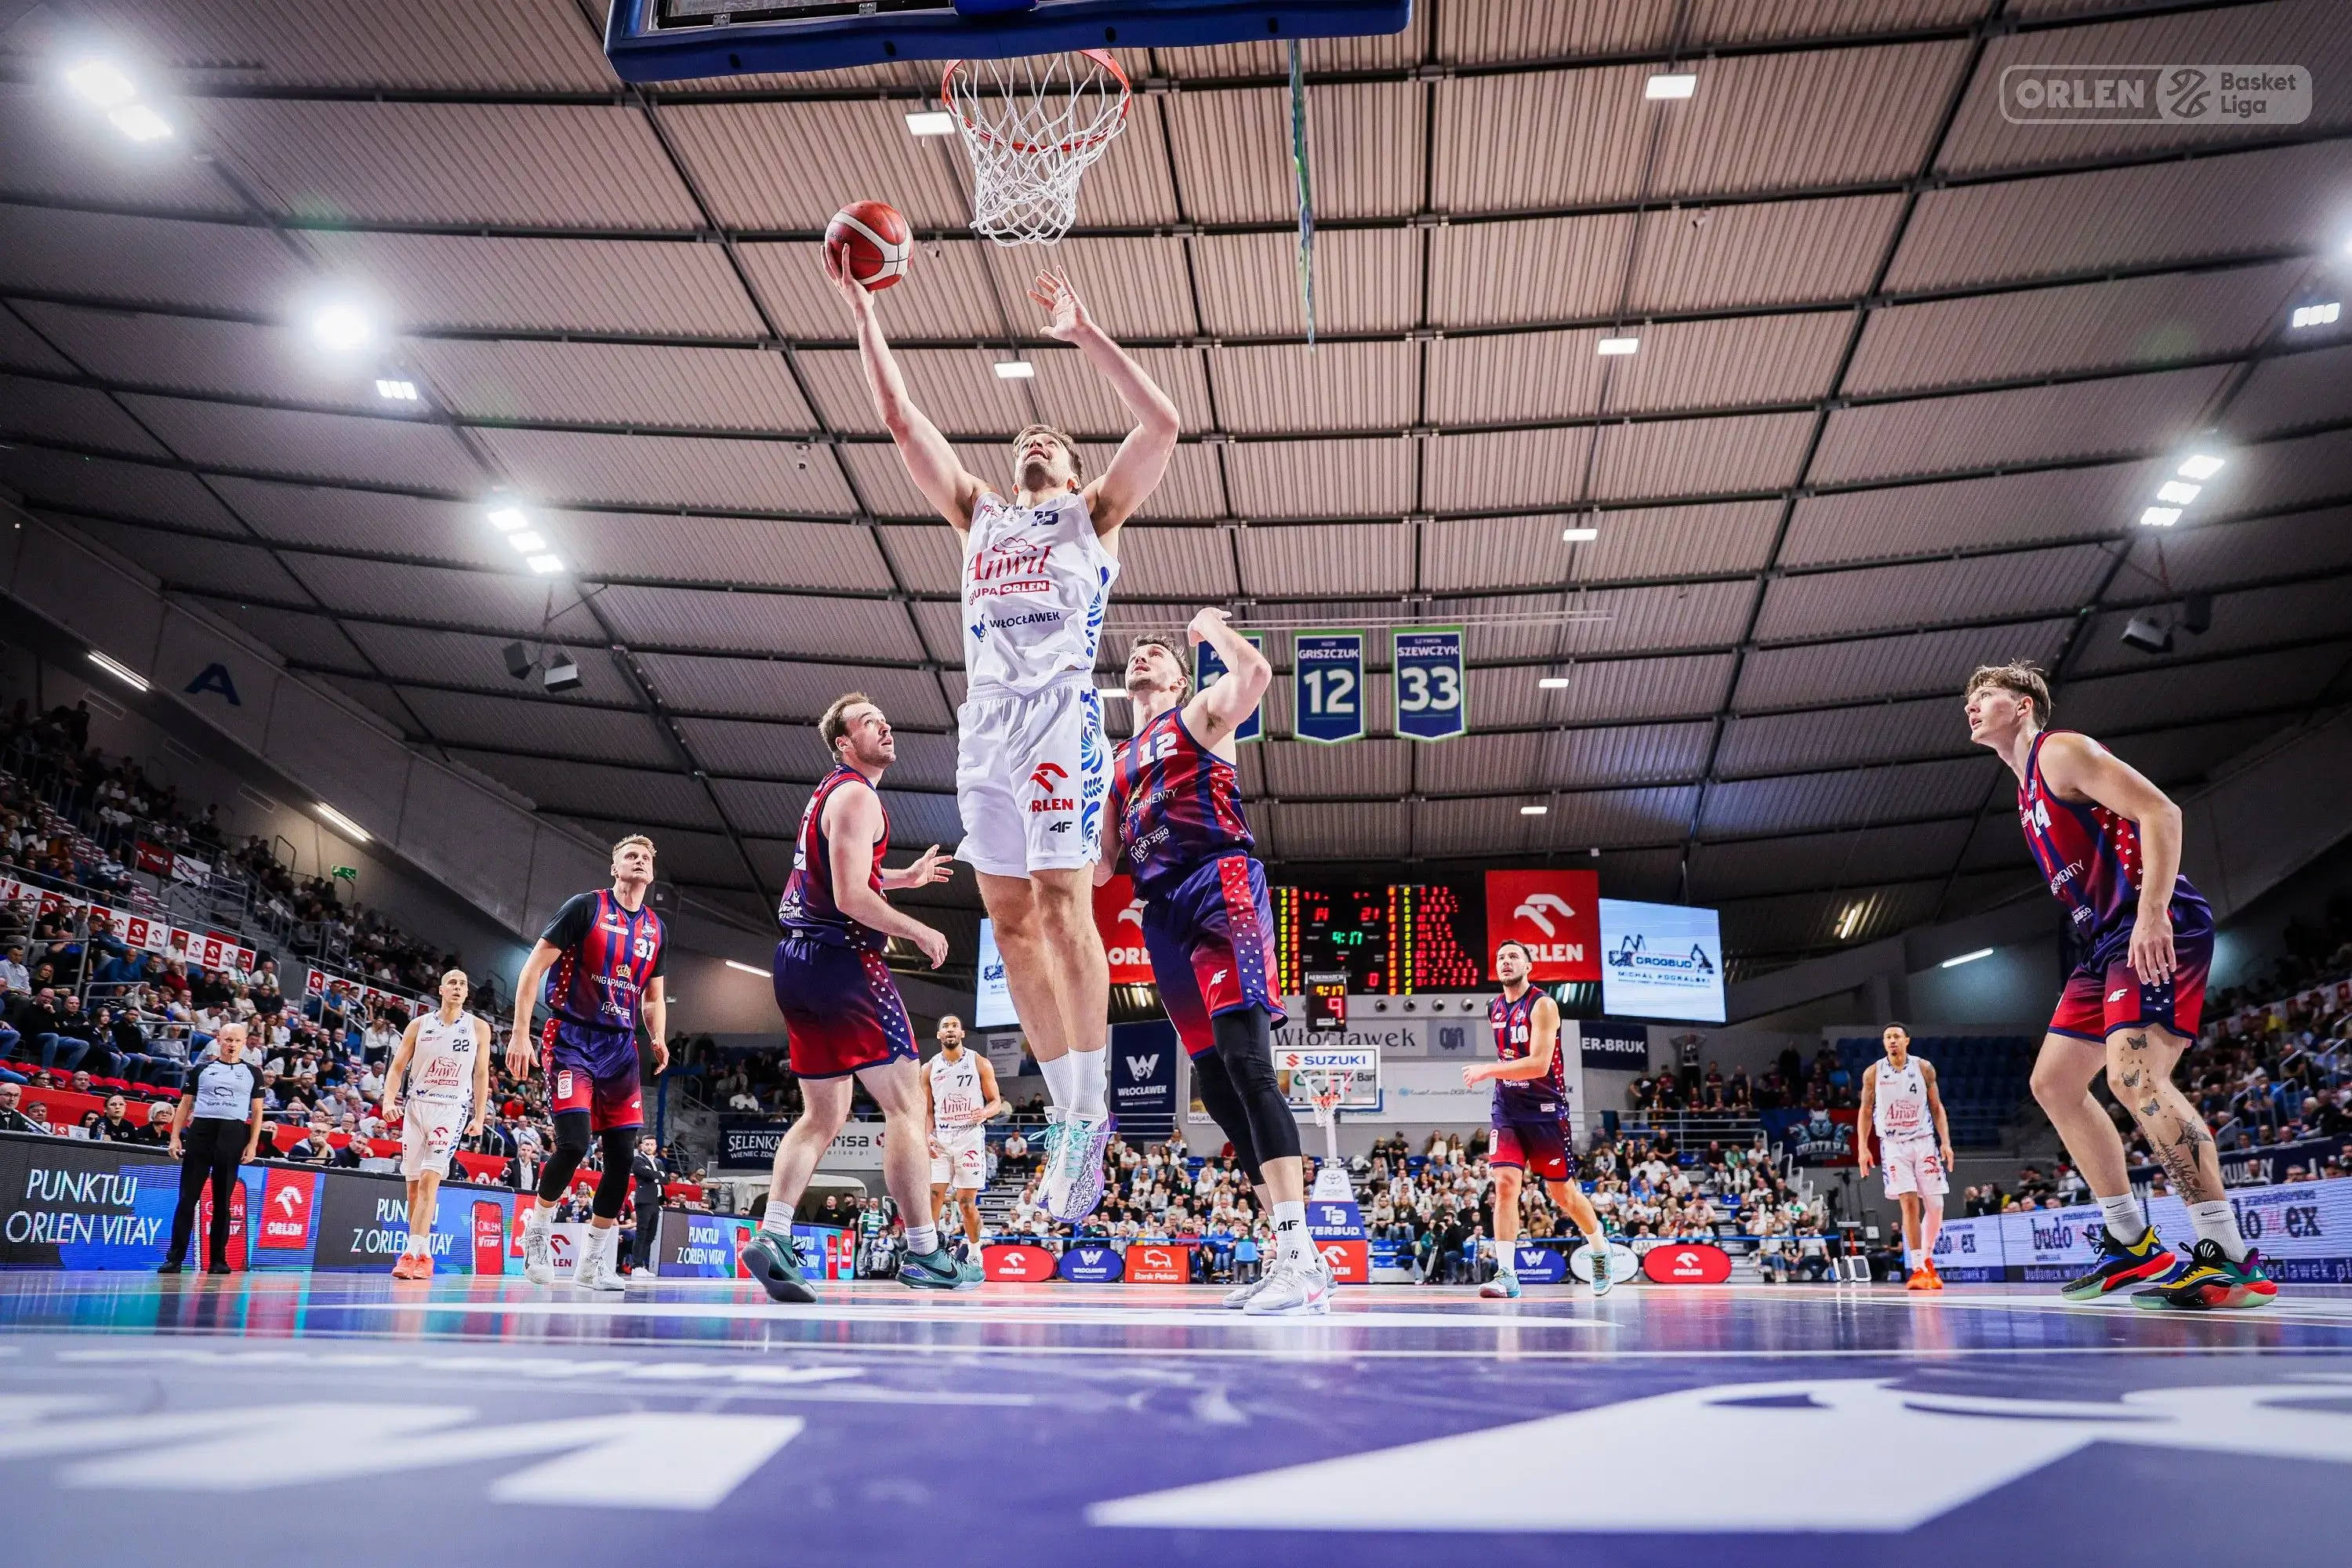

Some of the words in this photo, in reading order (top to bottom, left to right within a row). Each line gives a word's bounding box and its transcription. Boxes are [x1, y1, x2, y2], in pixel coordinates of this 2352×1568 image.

[967, 546, 1051, 588] Anwil
[968, 586, 998, 606] GRUPA
[1003, 580, 1047, 593] ORLEN
[989, 612, 1061, 629] WŁOCŁAWEK
[1398, 645, 1459, 657] SZEWCZYK
[183, 662, 242, 706] A
[1303, 669, 1355, 713] 12
[1400, 666, 1460, 711] 33
[1138, 732, 1178, 768] 12
[1029, 798, 1073, 812] RLEN
[1150, 828, 1169, 844] 2050
[1360, 907, 1380, 921] 21
[634, 938, 656, 961] 31
[1108, 947, 1151, 965] ORL
[1527, 944, 1584, 962] RLEN
[1369, 972, 1380, 986] 0
[1316, 985, 1345, 996] 9:17
[1328, 998, 1343, 1018] 9
[1274, 1027, 1417, 1048] Włocławek
[1510, 1025, 1529, 1044] 10
[452, 1040, 470, 1052] 22
[1581, 1037, 1646, 1054] ER-BRUK
[1305, 1056, 1366, 1065] SUZUKI
[425, 1064, 462, 1078] Anwil
[1357, 1073, 1377, 1081] Ban
[957, 1075, 973, 1087] 77
[1910, 1083, 1917, 1094] 4
[1118, 1085, 1167, 1096] WŁOCŁAWEK
[941, 1098, 972, 1114] Anwil
[832, 1135, 869, 1147] risa
[26, 1169, 138, 1206] PUNKTUJ
[5, 1210, 95, 1244] ORLEN
[103, 1214, 163, 1245] VITAY
[1278, 1220, 1299, 1232] 4F
[350, 1228, 364, 1253] Z
[431, 1234, 455, 1255] TAY
[677, 1247, 684, 1264] Z
[684, 1247, 707, 1265] ORLEN
[1134, 1272, 1152, 1280] Bank
[1155, 1272, 1178, 1280] Pekao
[1673, 1268, 1704, 1276] ORLEN
